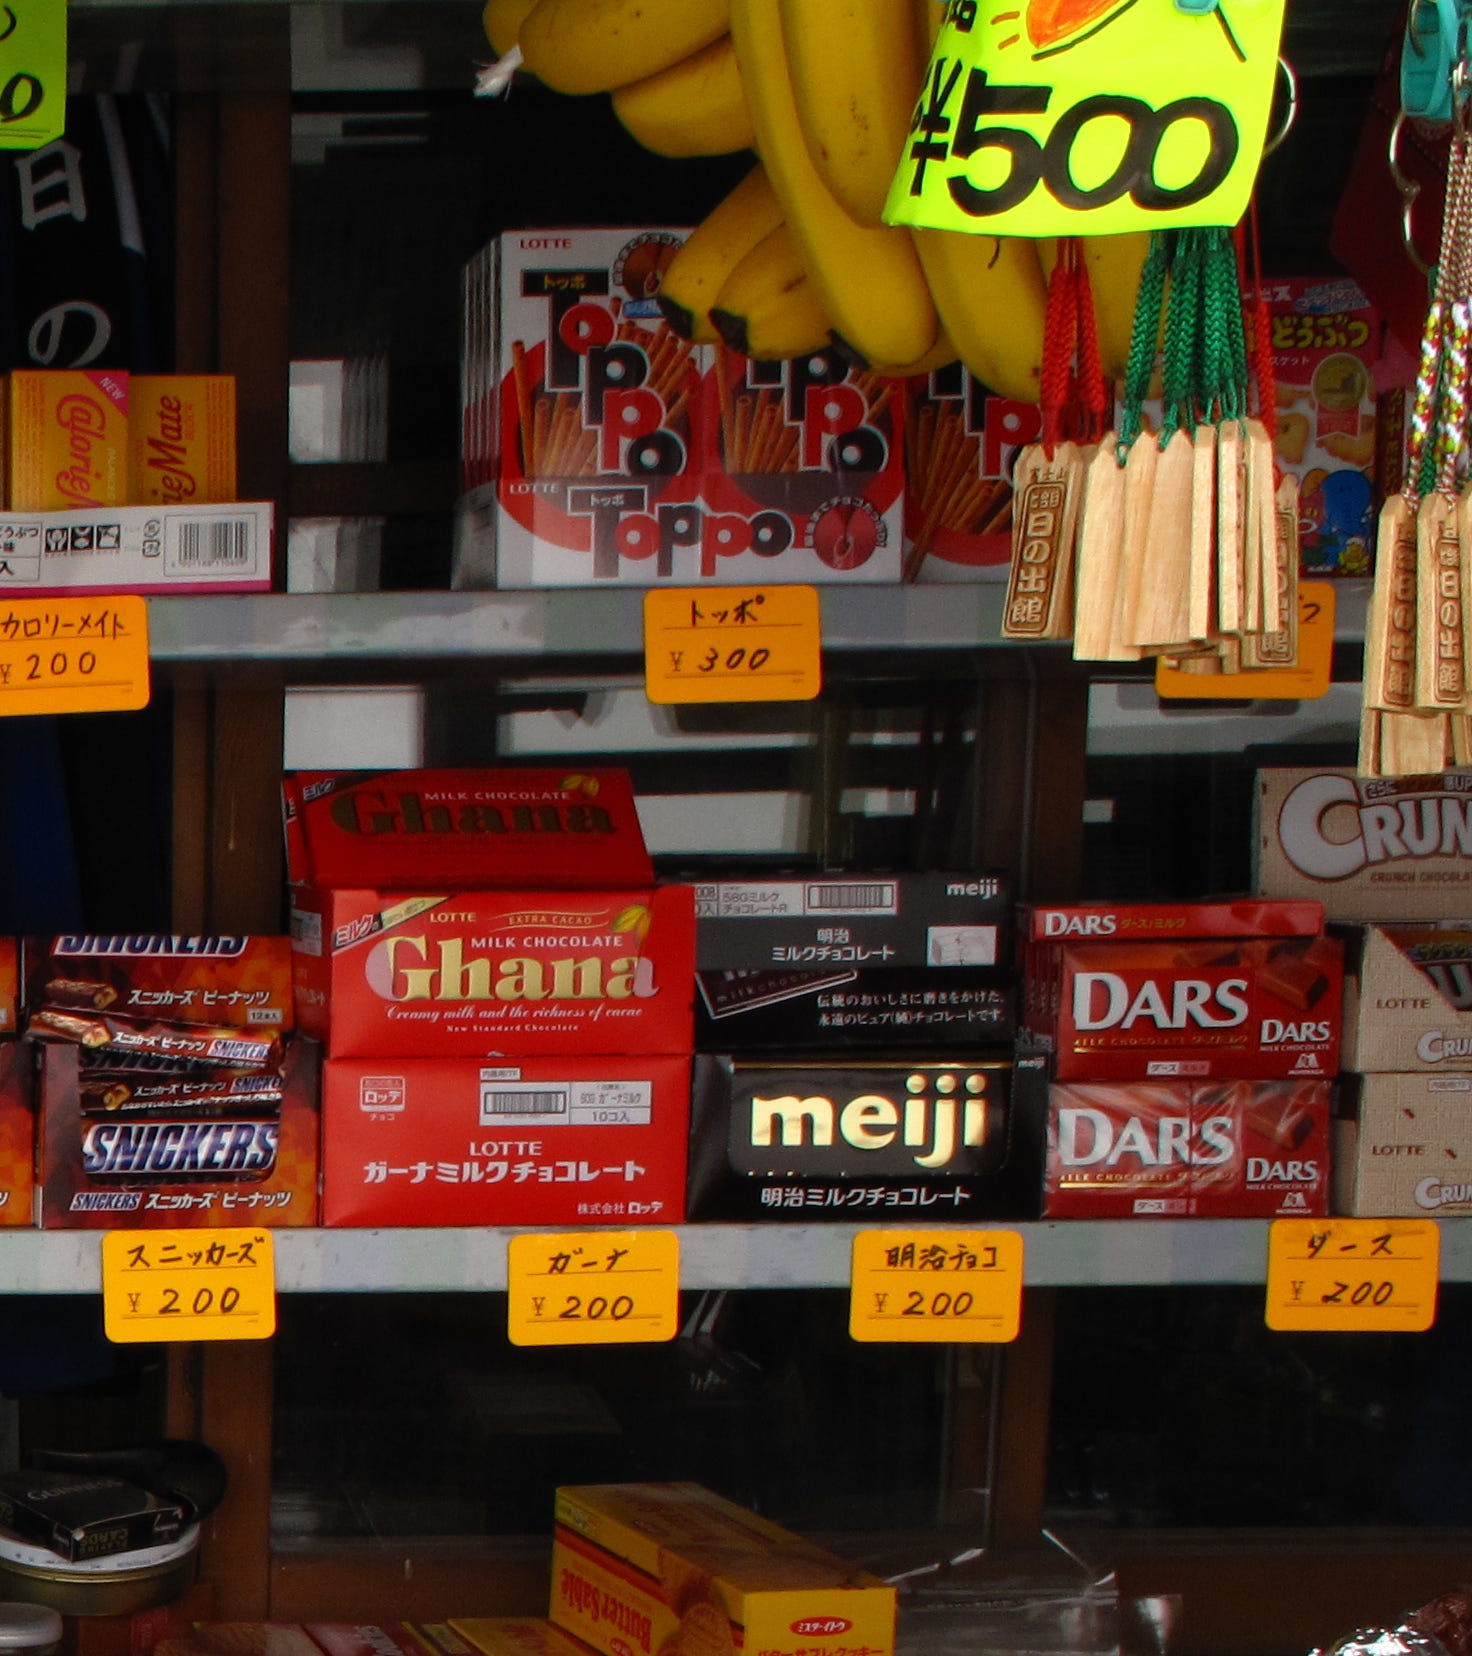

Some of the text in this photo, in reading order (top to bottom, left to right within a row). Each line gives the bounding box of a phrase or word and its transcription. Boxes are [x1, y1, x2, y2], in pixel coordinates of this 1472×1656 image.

[910, 55, 1239, 217] ¥500
[519, 237, 572, 250] LOTTE
[99, 376, 124, 401] NEW
[689, 595, 766, 626] トッポ
[0, 612, 125, 641] カロリーメイト
[946, 878, 999, 897] meiji
[429, 912, 477, 923] LOTTE
[1044, 911, 1117, 937] DARS
[470, 934, 624, 949] MILK CHOCOLATE
[816, 928, 850, 944] 明治
[771, 946, 896, 962] ミルクチョコレート
[365, 935, 660, 1002] Ghana
[203, 989, 271, 1007] ピーナッツ
[1073, 971, 1249, 1033] DARS
[1376, 999, 1431, 1010] LOTTE
[385, 1005, 644, 1024] Creamy milk and the richness cacao
[472, 1024, 579, 1033] Standard Chocolate
[1259, 1019, 1331, 1045] DARS
[364, 1090, 402, 1104] ロッテ
[751, 1072, 987, 1169] meiji
[1057, 1108, 1236, 1167] DARS
[83, 1122, 280, 1175] SNICKERS
[470, 1141, 542, 1156] LOTTE
[1372, 1145, 1426, 1156] LOTTE
[364, 1161, 646, 1183] ガーナミルクチョコレート
[1246, 1157, 1318, 1183] DARS
[69, 1193, 142, 1211] SNICKERS
[760, 1187, 971, 1206] 明治ミルクチョコレート
[577, 1201, 663, 1214] 株式会社 ロッテ
[125, 1235, 267, 1268] スニッカーズ
[547, 1247, 630, 1274] ガーナ
[885, 1242, 998, 1269] 明治チョコ
